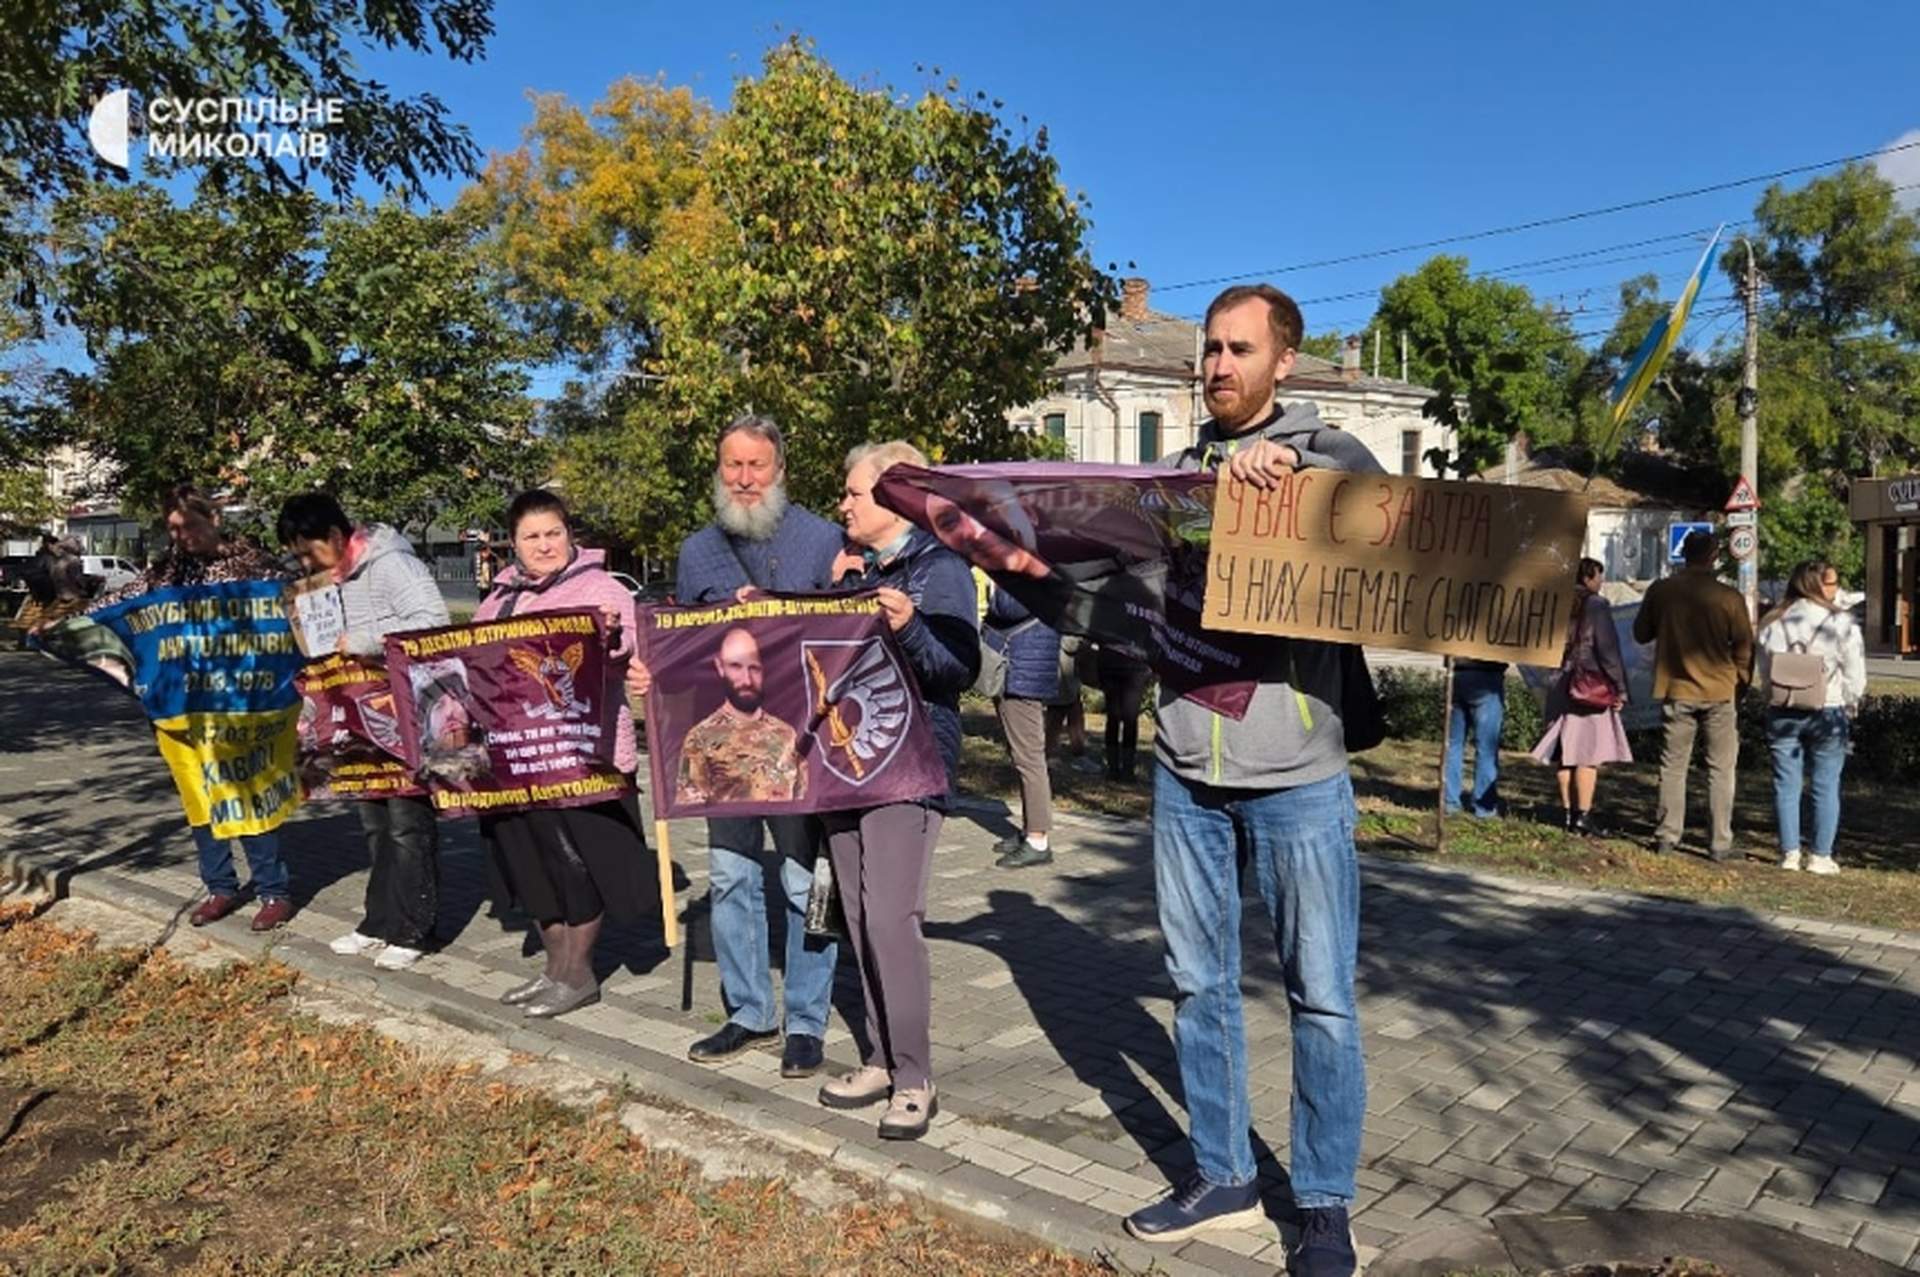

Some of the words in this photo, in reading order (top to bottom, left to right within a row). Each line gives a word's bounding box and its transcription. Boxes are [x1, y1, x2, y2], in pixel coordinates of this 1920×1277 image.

[1226, 476, 1244, 536] У
[1253, 473, 1314, 541] ВАС
[1329, 479, 1350, 545] Є
[1368, 483, 1493, 558] ЗАВТРА
[1734, 536, 1751, 549] 40
[1214, 552, 1236, 618] У
[1243, 557, 1310, 625] НИХ
[1315, 564, 1420, 636] НЕМАЄ
[1422, 575, 1559, 651] СЬОГОДНІ
